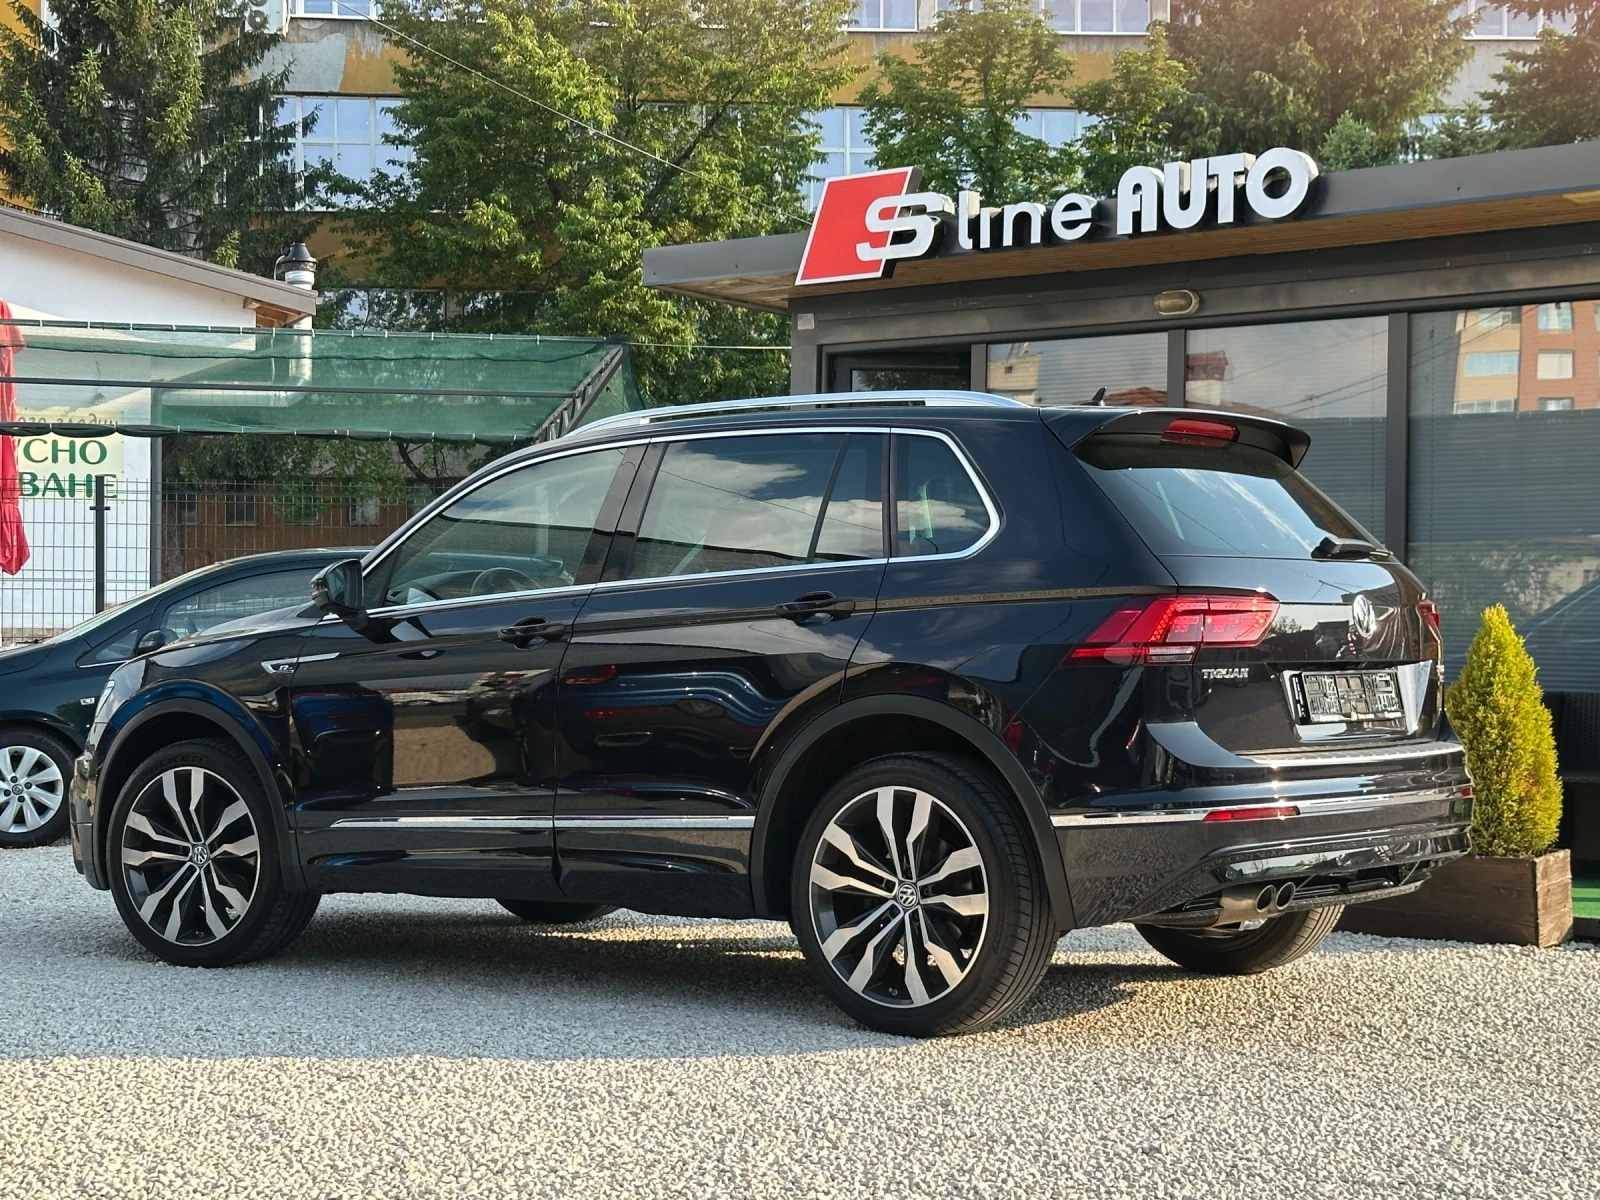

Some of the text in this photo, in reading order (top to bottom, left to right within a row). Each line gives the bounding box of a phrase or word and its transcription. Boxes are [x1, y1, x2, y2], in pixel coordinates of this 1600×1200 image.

[856, 192, 945, 262] S
[1117, 147, 1311, 235] AUTO
[1201, 667, 1249, 679] TIGUAN
